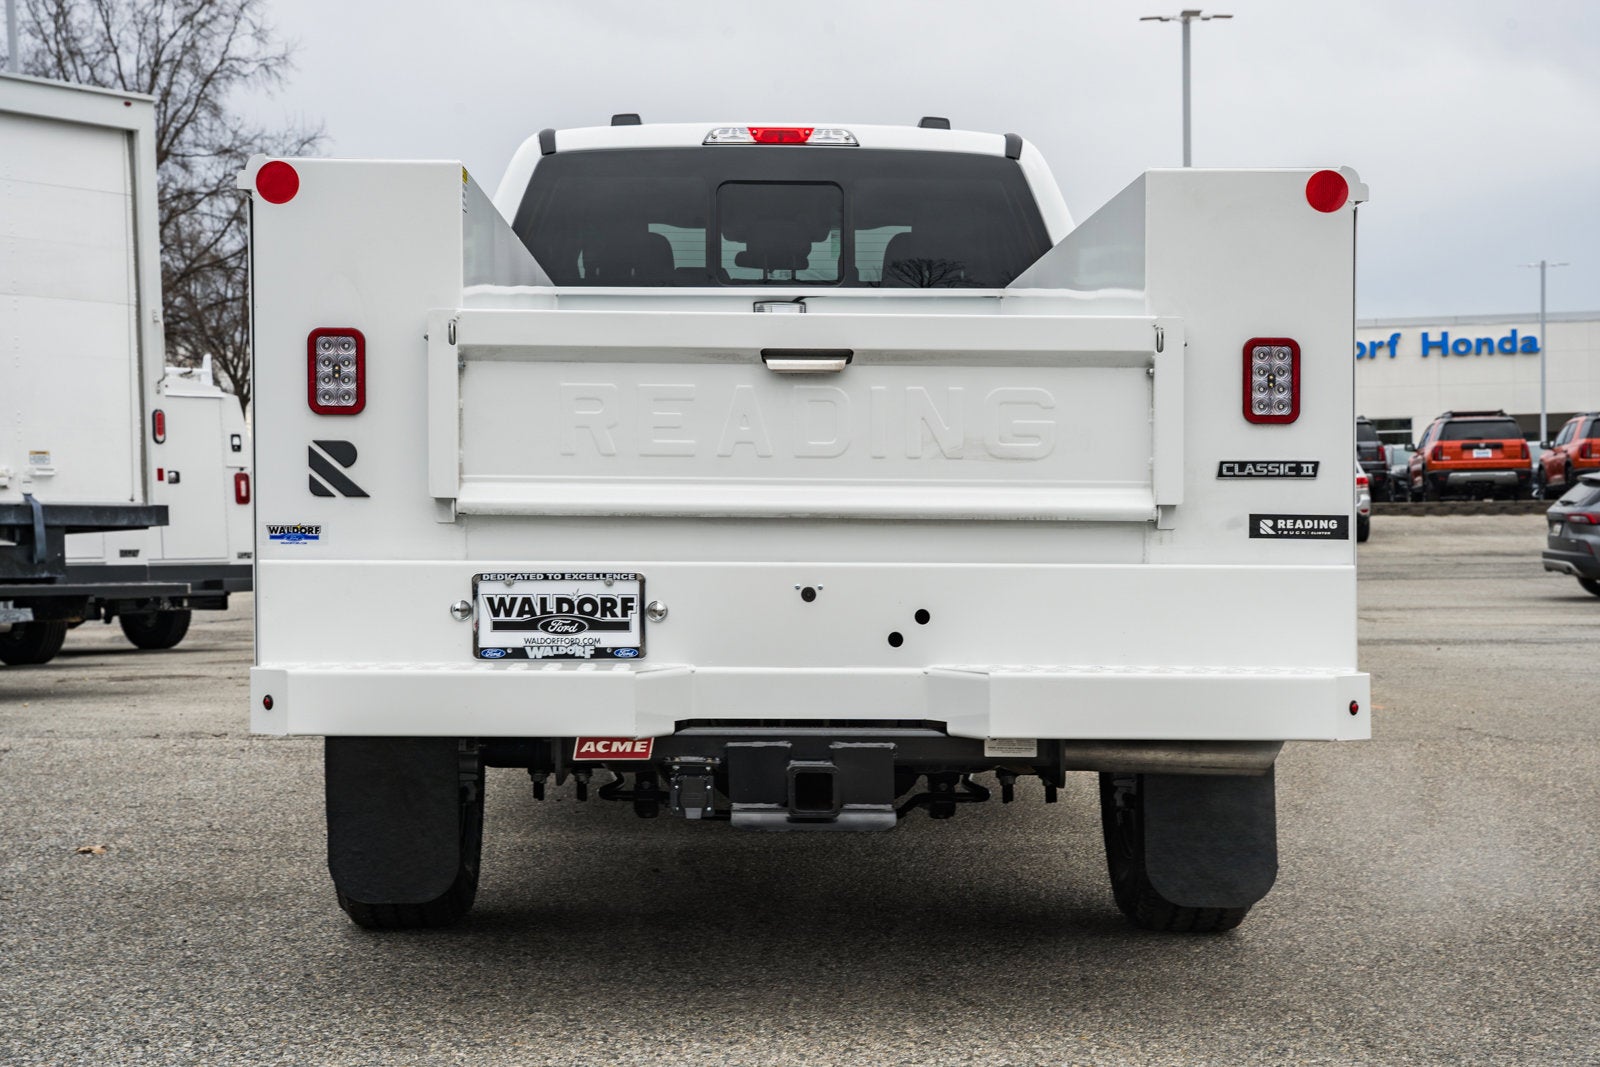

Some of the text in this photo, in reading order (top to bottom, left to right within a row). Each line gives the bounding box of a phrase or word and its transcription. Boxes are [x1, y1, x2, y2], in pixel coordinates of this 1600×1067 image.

[1421, 329, 1540, 357] Honda
[560, 383, 1056, 460] READING
[1222, 463, 1315, 476] CLASSIC II
[268, 526, 320, 534] WALDORF
[1277, 519, 1338, 529] READING
[564, 573, 636, 581] EXCELLENCE
[484, 596, 636, 618] WALDORF
[549, 620, 579, 633] Ford
[524, 637, 601, 645] WALDORFFORD.COM
[485, 649, 503, 657] Ford
[525, 644, 595, 658] WALDORF
[617, 648, 636, 657] Ford
[580, 741, 648, 753] ACME
